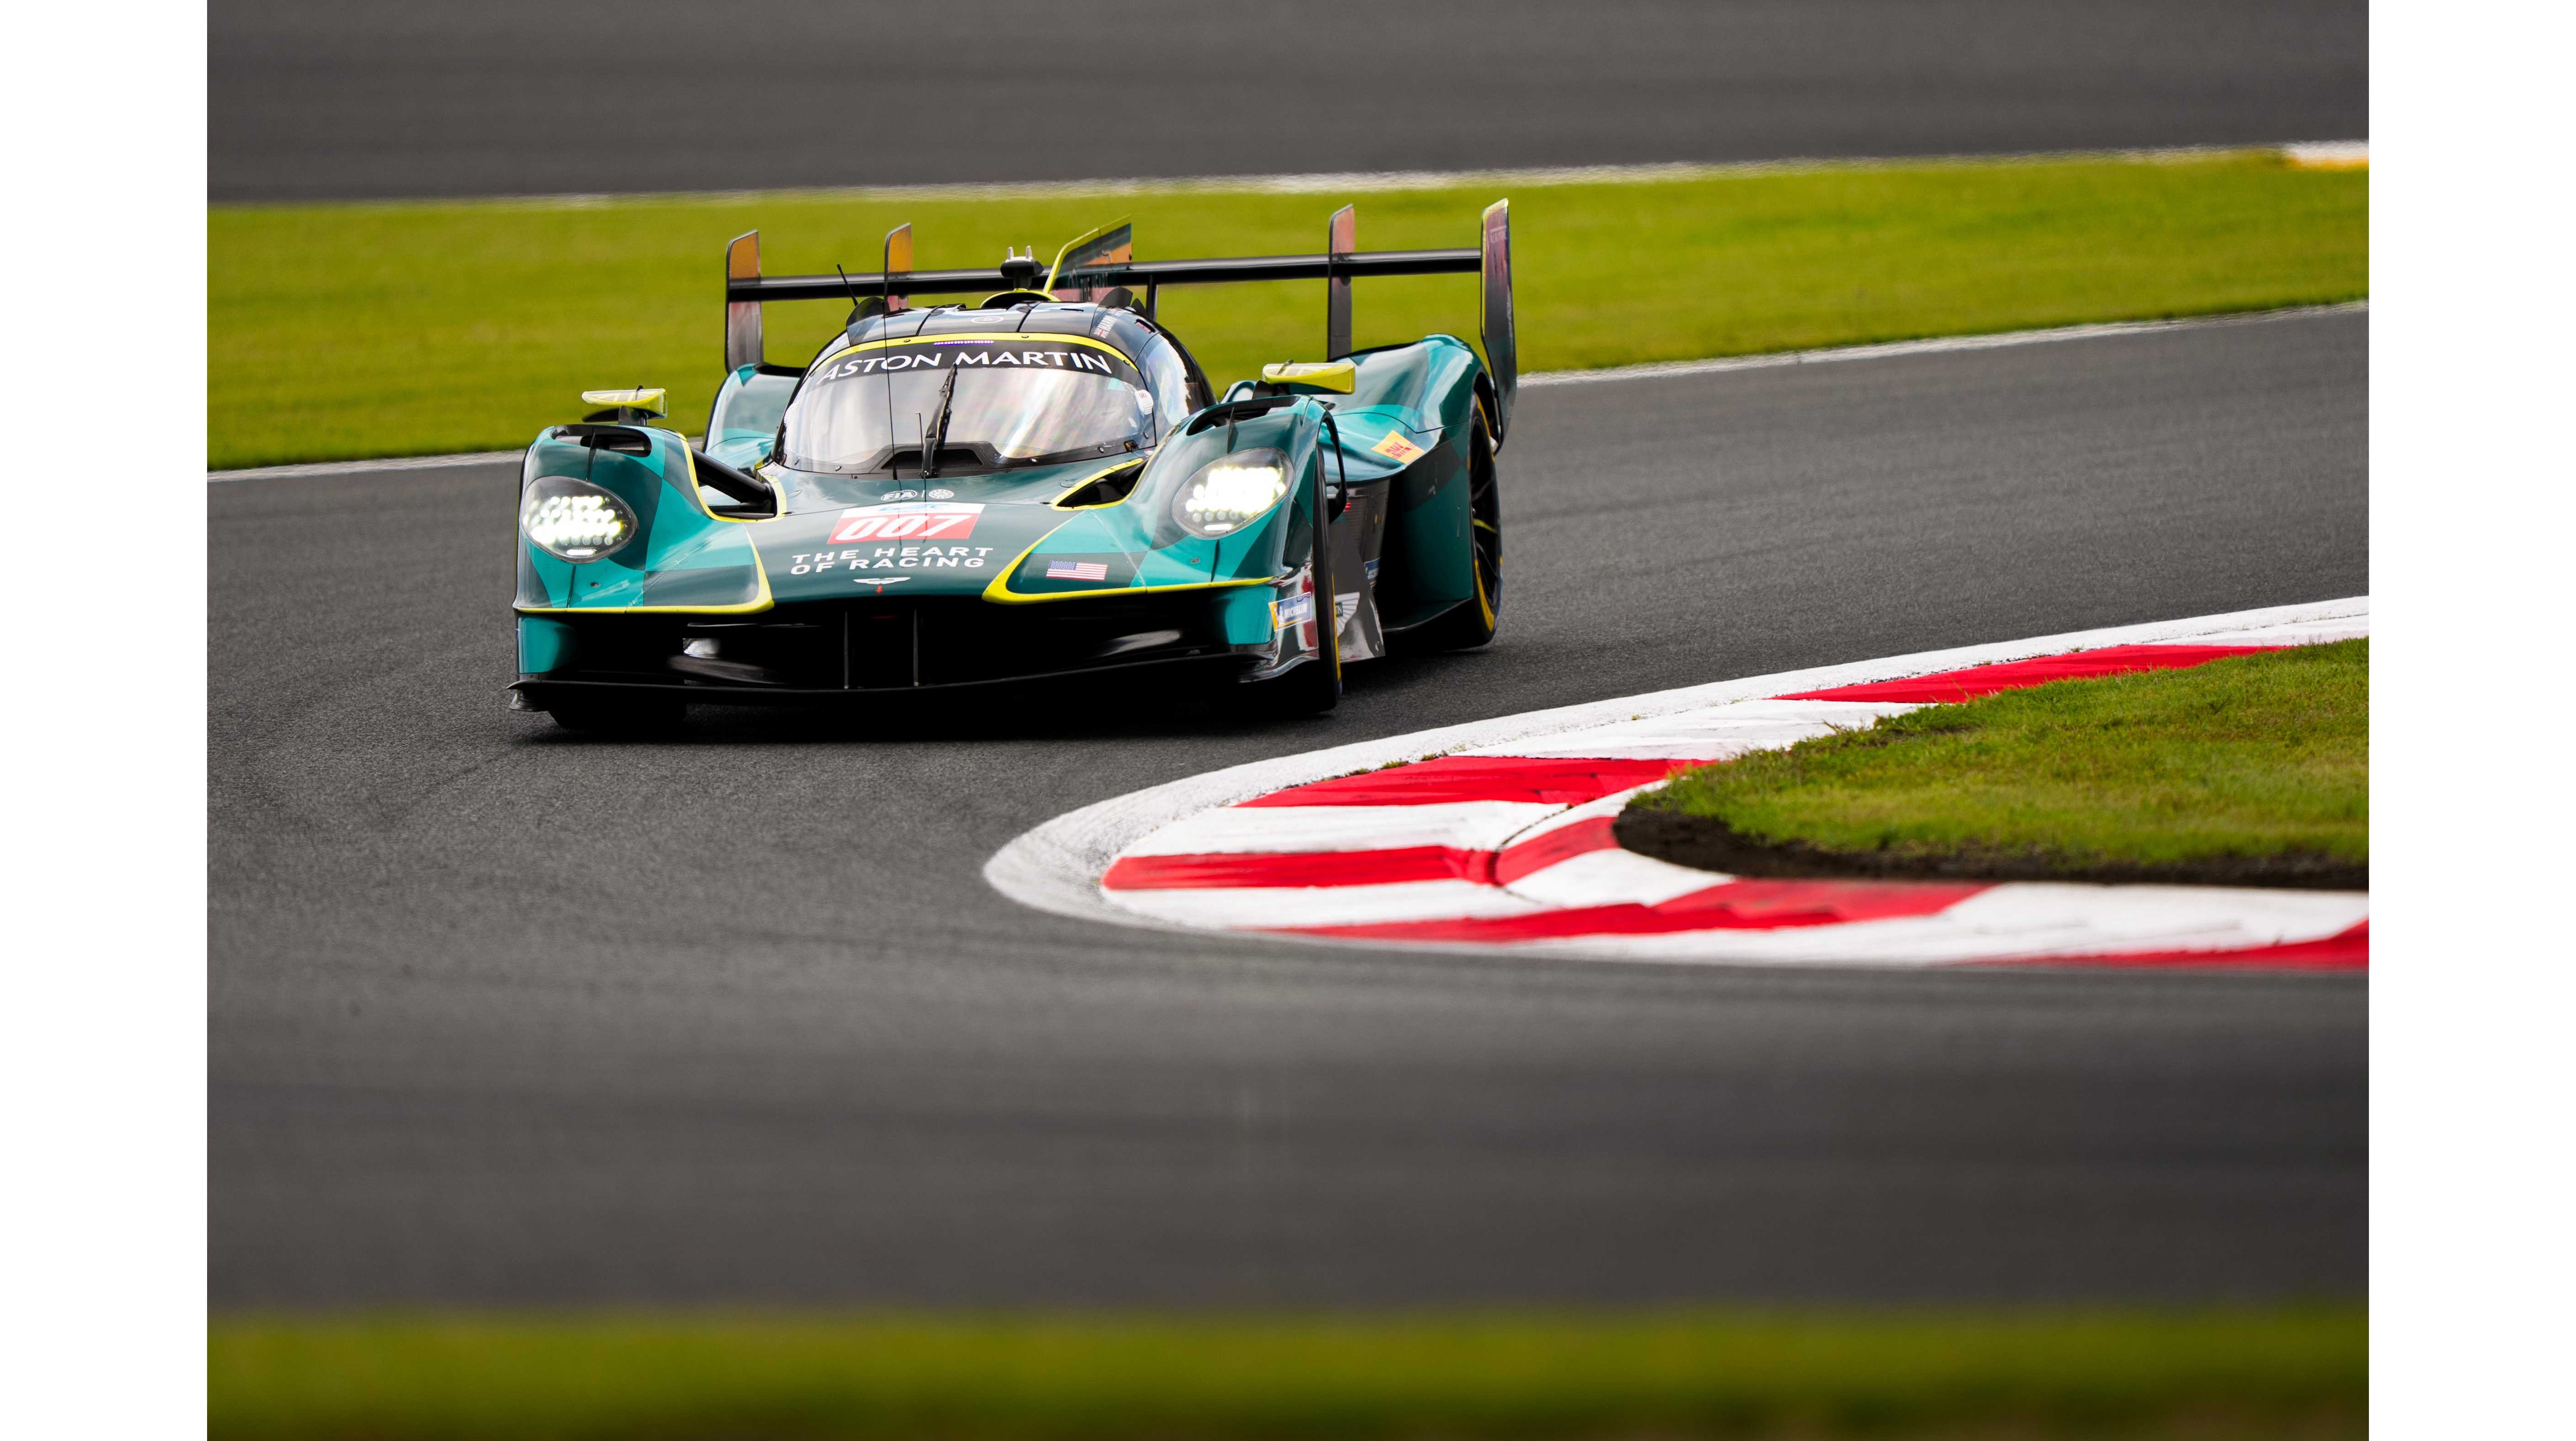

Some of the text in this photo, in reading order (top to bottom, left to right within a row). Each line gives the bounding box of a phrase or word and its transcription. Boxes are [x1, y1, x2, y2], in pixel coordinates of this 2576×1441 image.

[817, 351, 1112, 383] ASTON MARTIN
[835, 515, 974, 541] 007
[790, 547, 994, 564] THE HEART
[790, 557, 985, 575] OF RACING
[1284, 602, 1308, 619] MICHELIN
